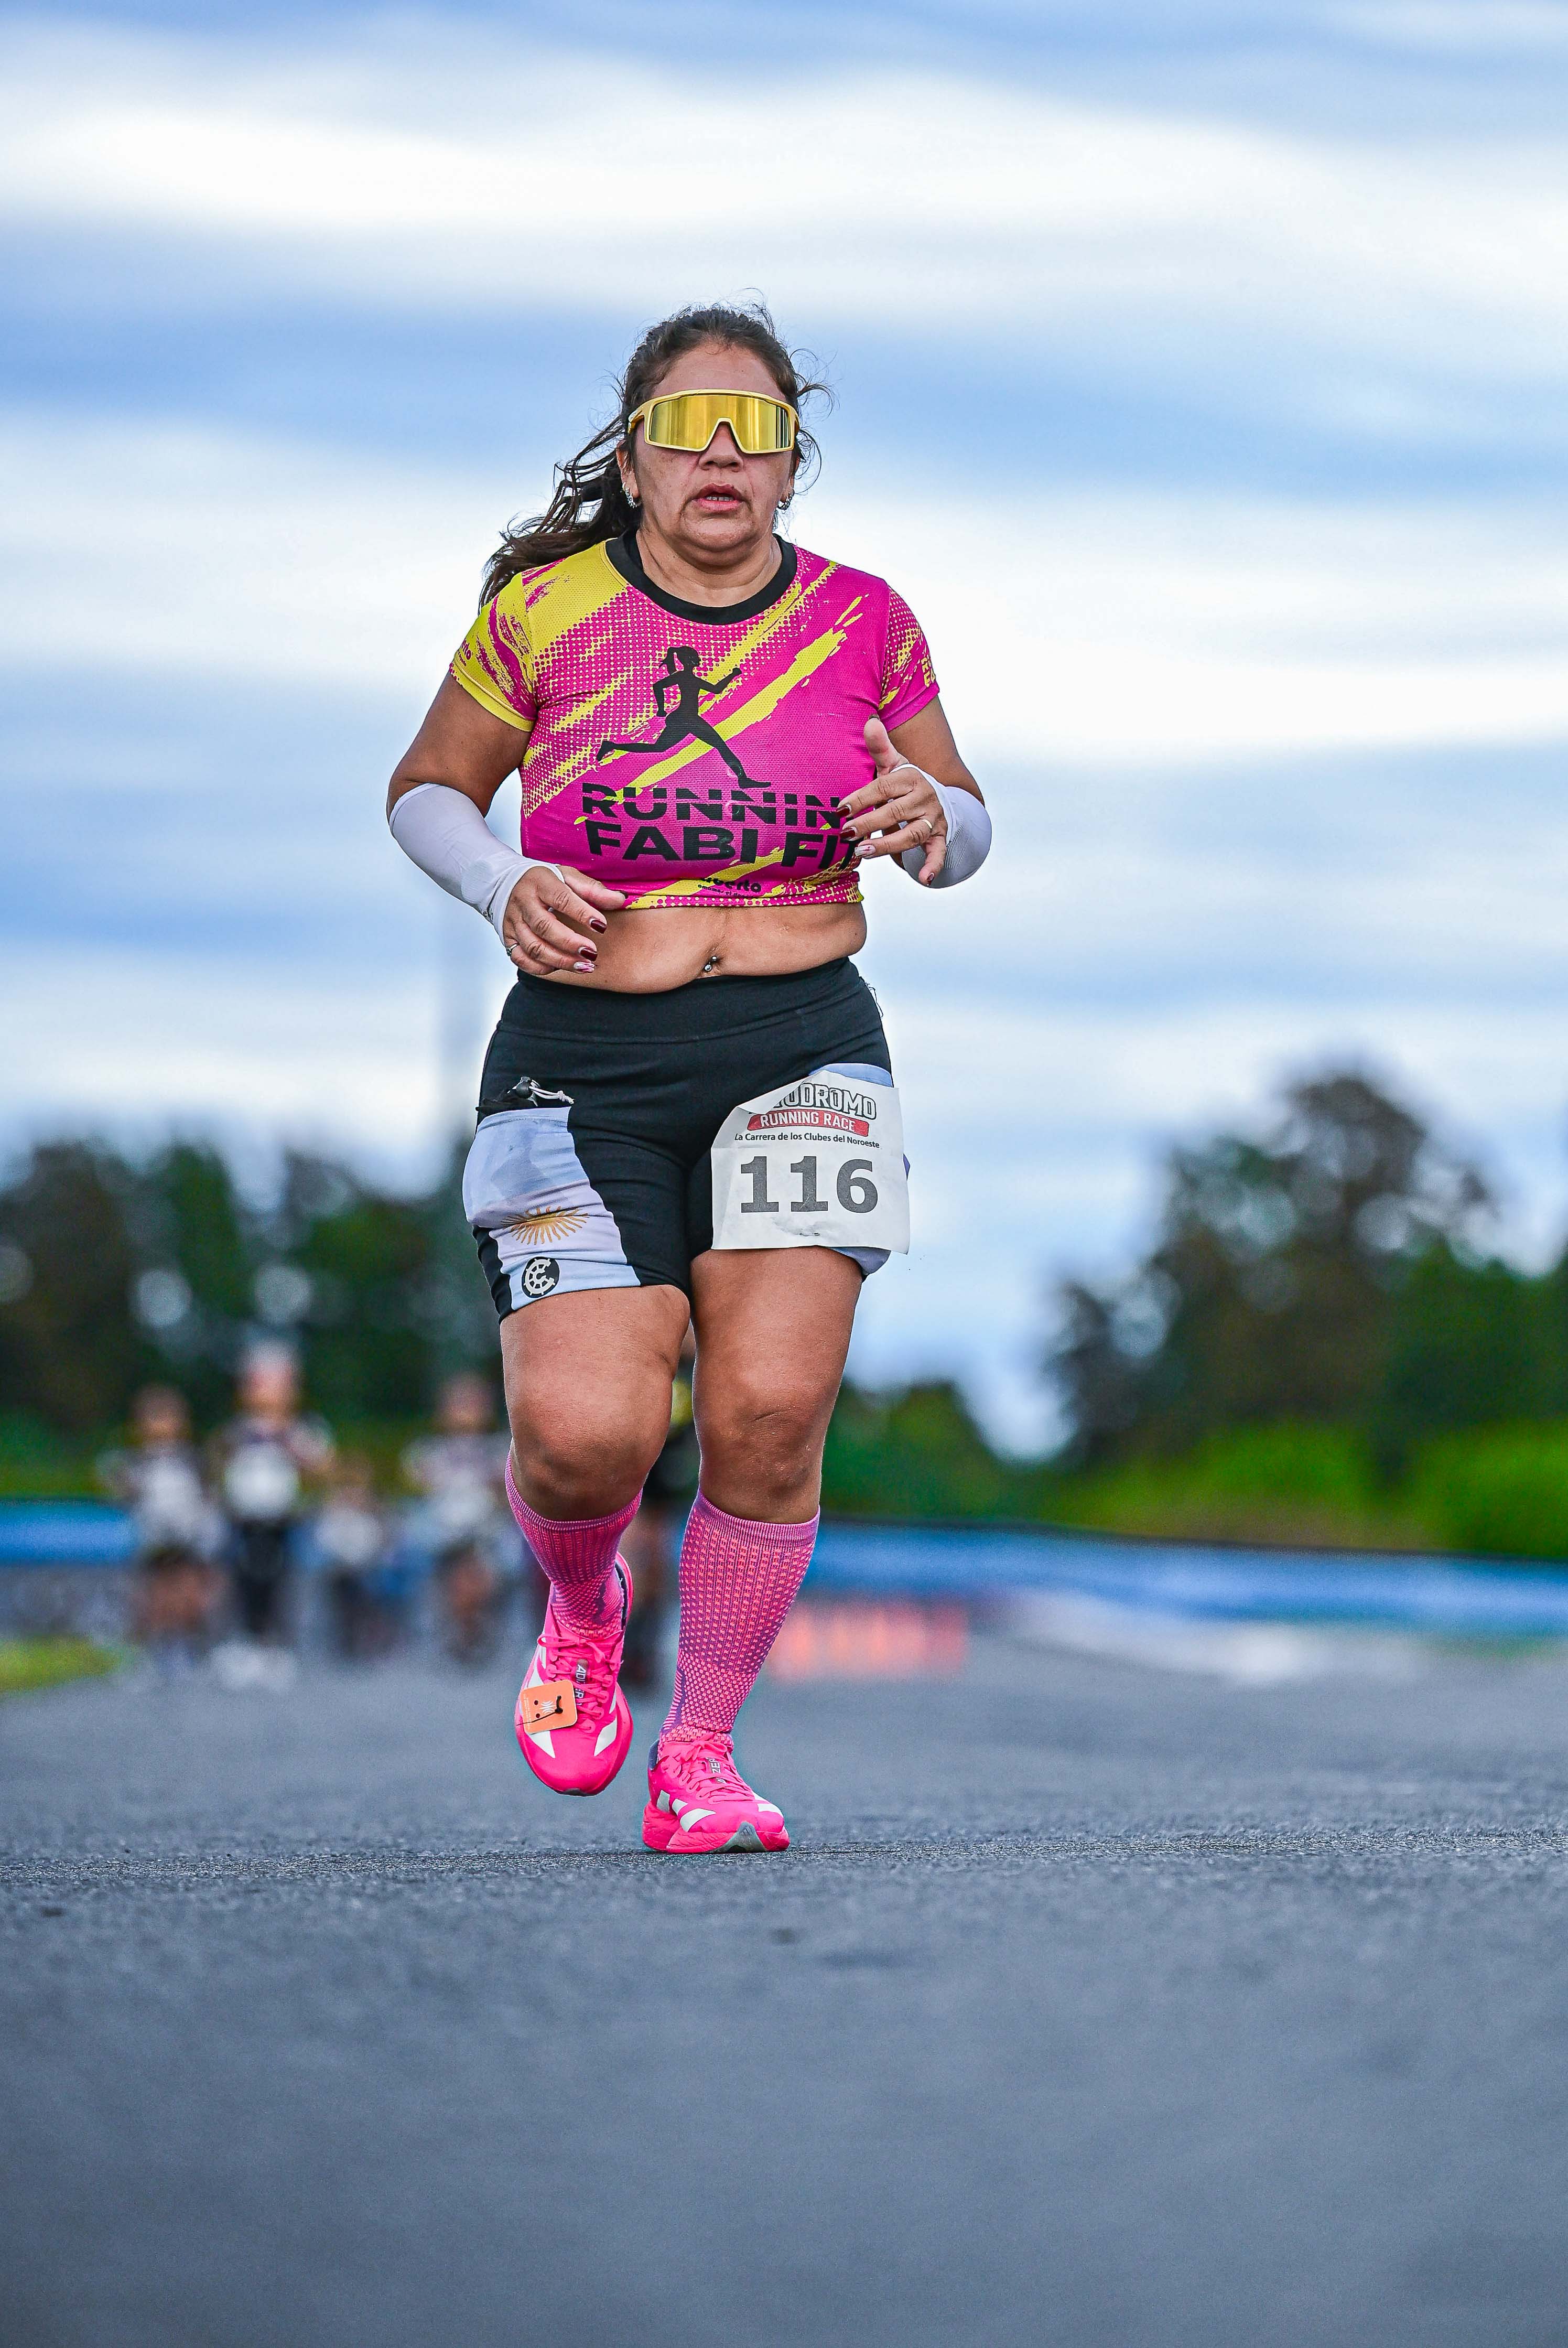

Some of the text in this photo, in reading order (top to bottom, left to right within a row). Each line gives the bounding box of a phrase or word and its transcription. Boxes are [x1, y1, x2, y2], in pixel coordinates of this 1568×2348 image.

[582, 782, 841, 828] RUNNIN
[585, 819, 864, 869] FABI FIT
[760, 1111, 856, 1132] RUNNING RACE
[773, 1083, 877, 1120] ODROMO
[804, 1133, 831, 1141] Clubes
[847, 1136, 880, 1148] Noroeste
[740, 1156, 878, 1213] 116
